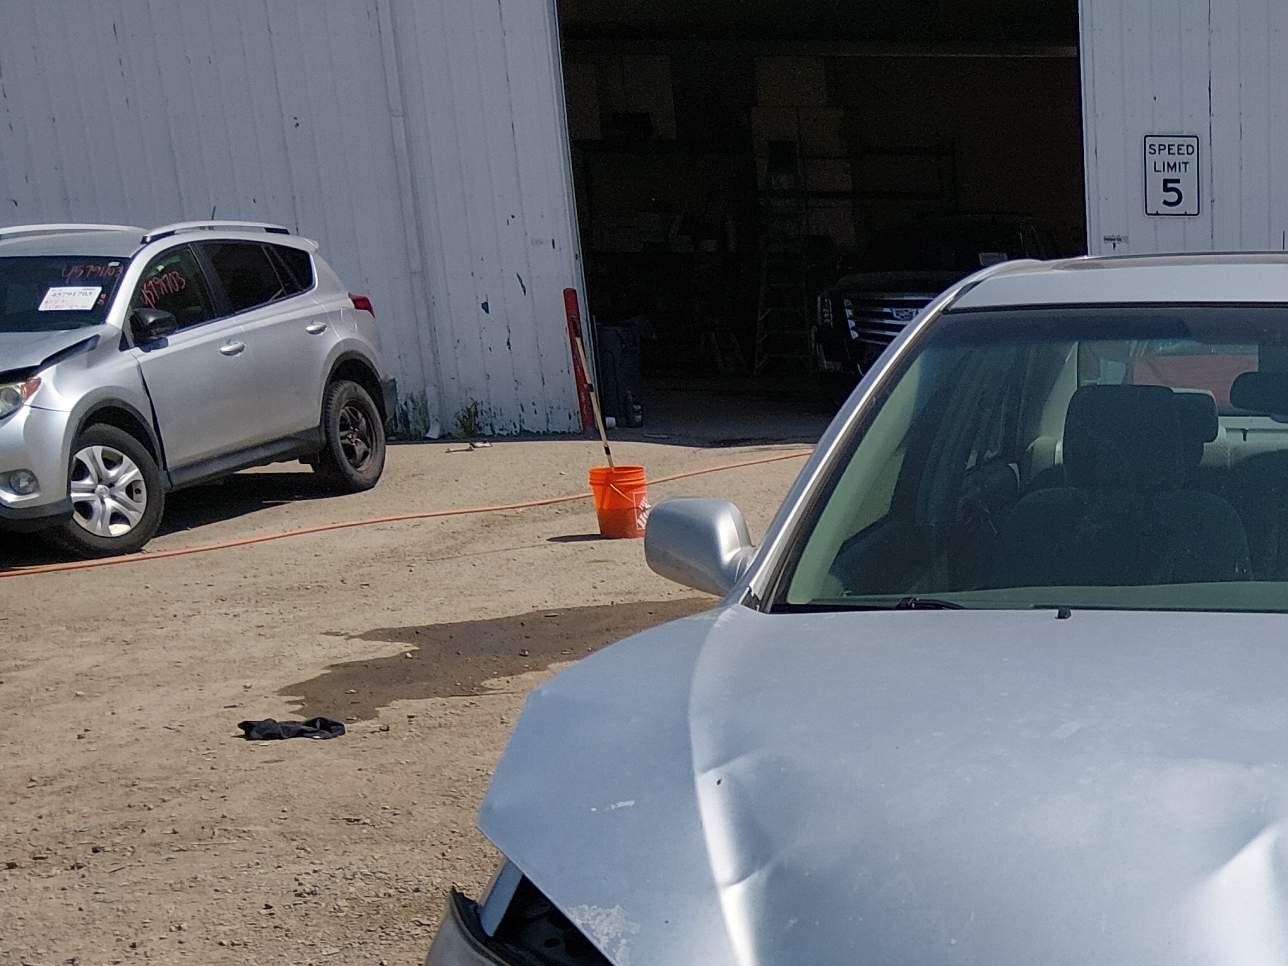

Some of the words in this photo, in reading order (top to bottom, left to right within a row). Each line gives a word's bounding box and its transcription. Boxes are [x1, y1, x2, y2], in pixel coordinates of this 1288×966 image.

[1148, 143, 1195, 155] SPEED
[1153, 161, 1190, 173] LIMIT
[1162, 178, 1183, 207] 5
